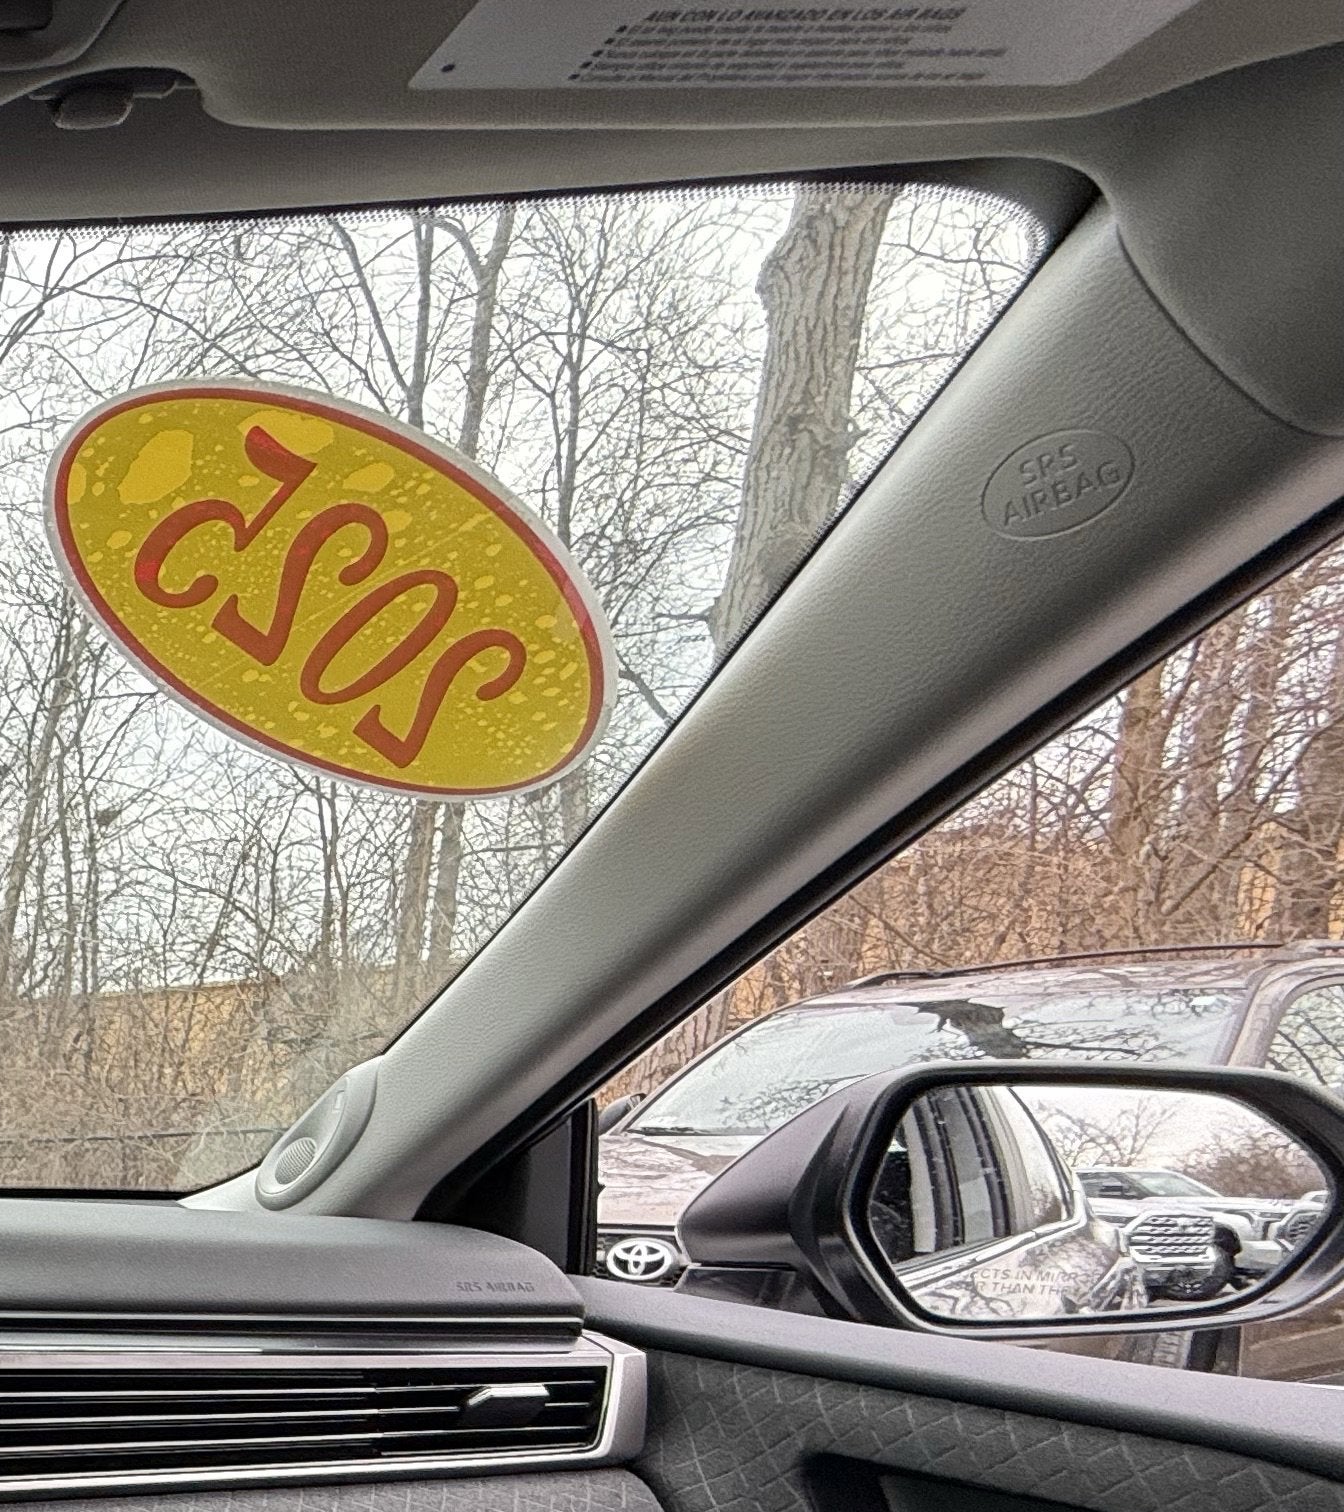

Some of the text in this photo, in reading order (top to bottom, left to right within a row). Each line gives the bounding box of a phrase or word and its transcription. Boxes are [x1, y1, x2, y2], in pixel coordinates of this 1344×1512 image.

[1019, 443, 1078, 488] SRS
[1003, 461, 1120, 527] AIRBAG
[1015, 1269, 1032, 1279] IN
[456, 1281, 535, 1293] SRS AIRBAG
[993, 1281, 1035, 1294] THAN
